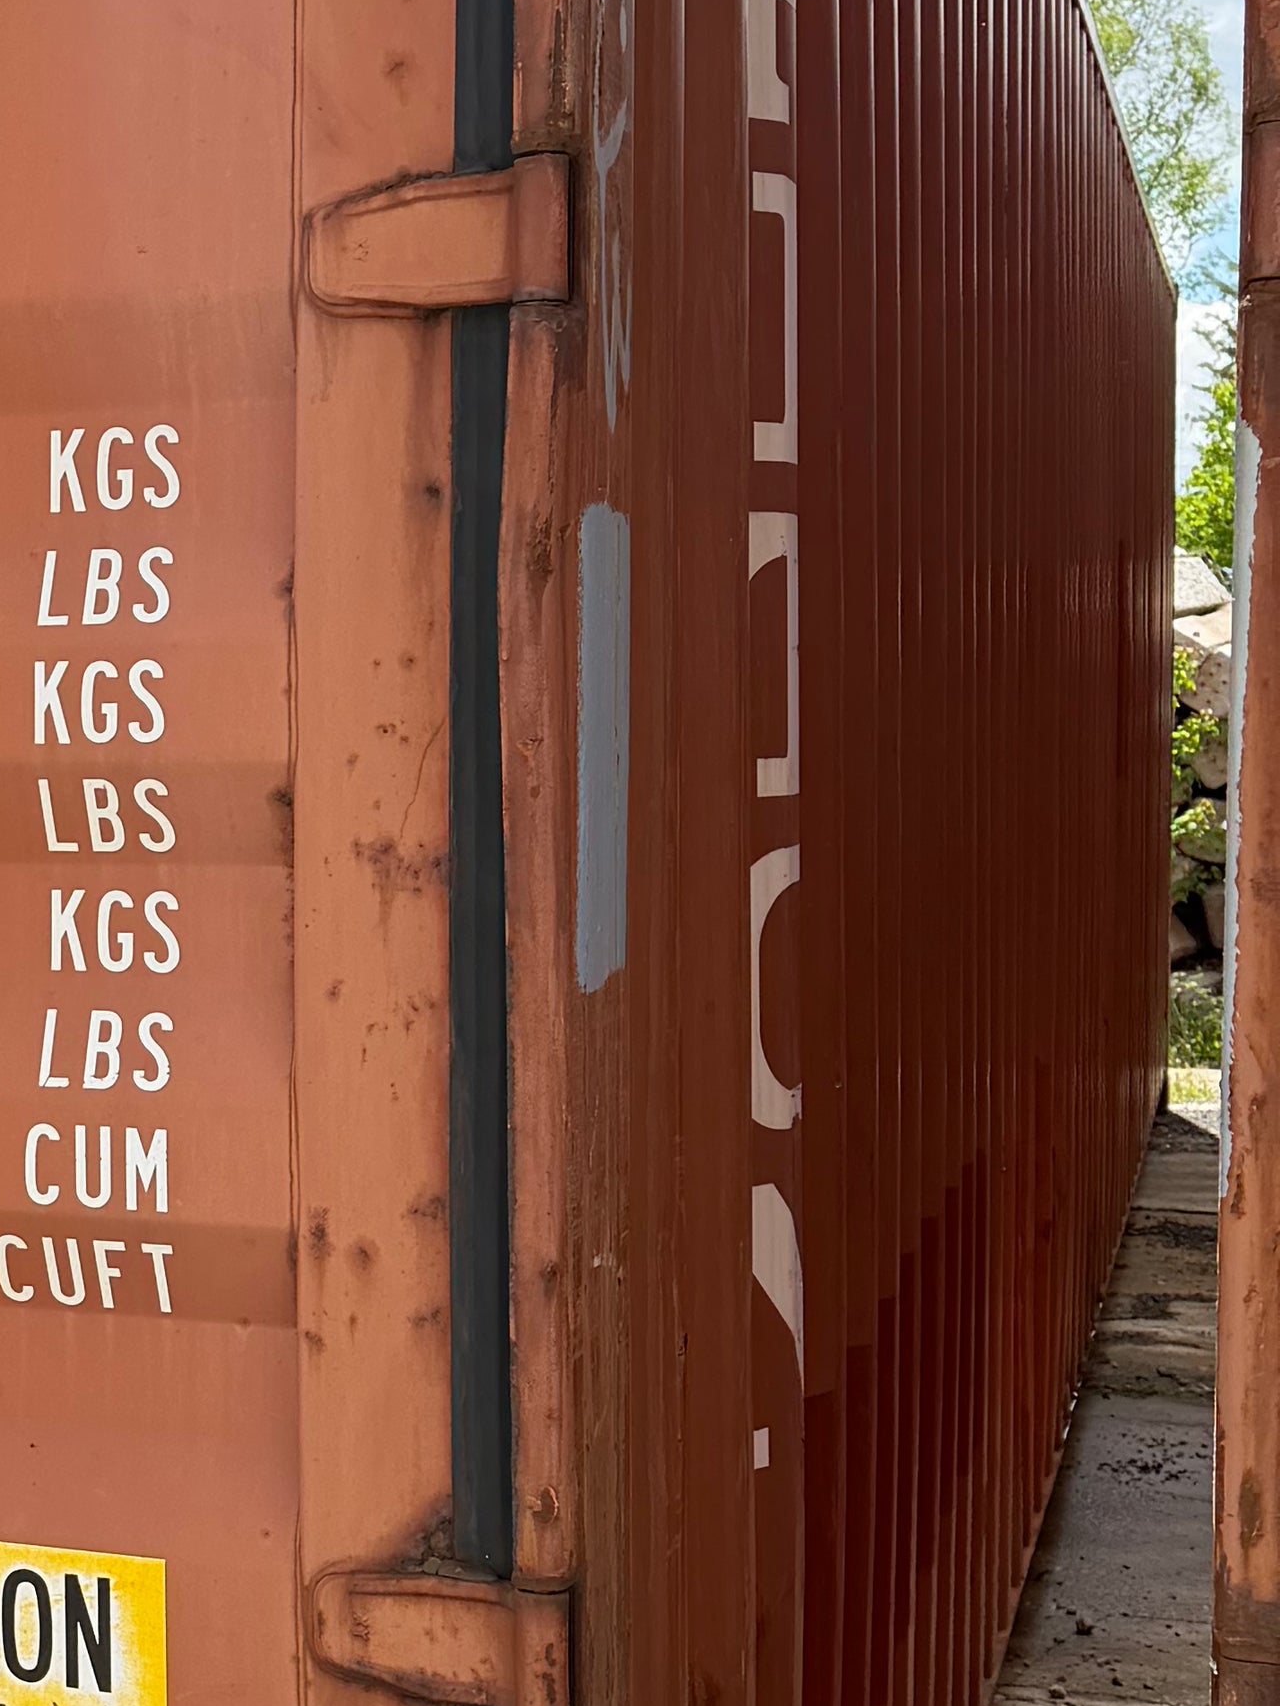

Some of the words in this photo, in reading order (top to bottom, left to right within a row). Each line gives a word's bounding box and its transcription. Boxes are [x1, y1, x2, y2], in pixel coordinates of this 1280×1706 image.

[50, 425, 179, 513] KGS
[37, 547, 173, 626] LBS
[35, 660, 164, 744] KGS
[38, 779, 175, 852] LBS
[51, 890, 179, 973] KGS
[39, 1009, 173, 1091] LBS
[25, 1124, 168, 1212] CUM
